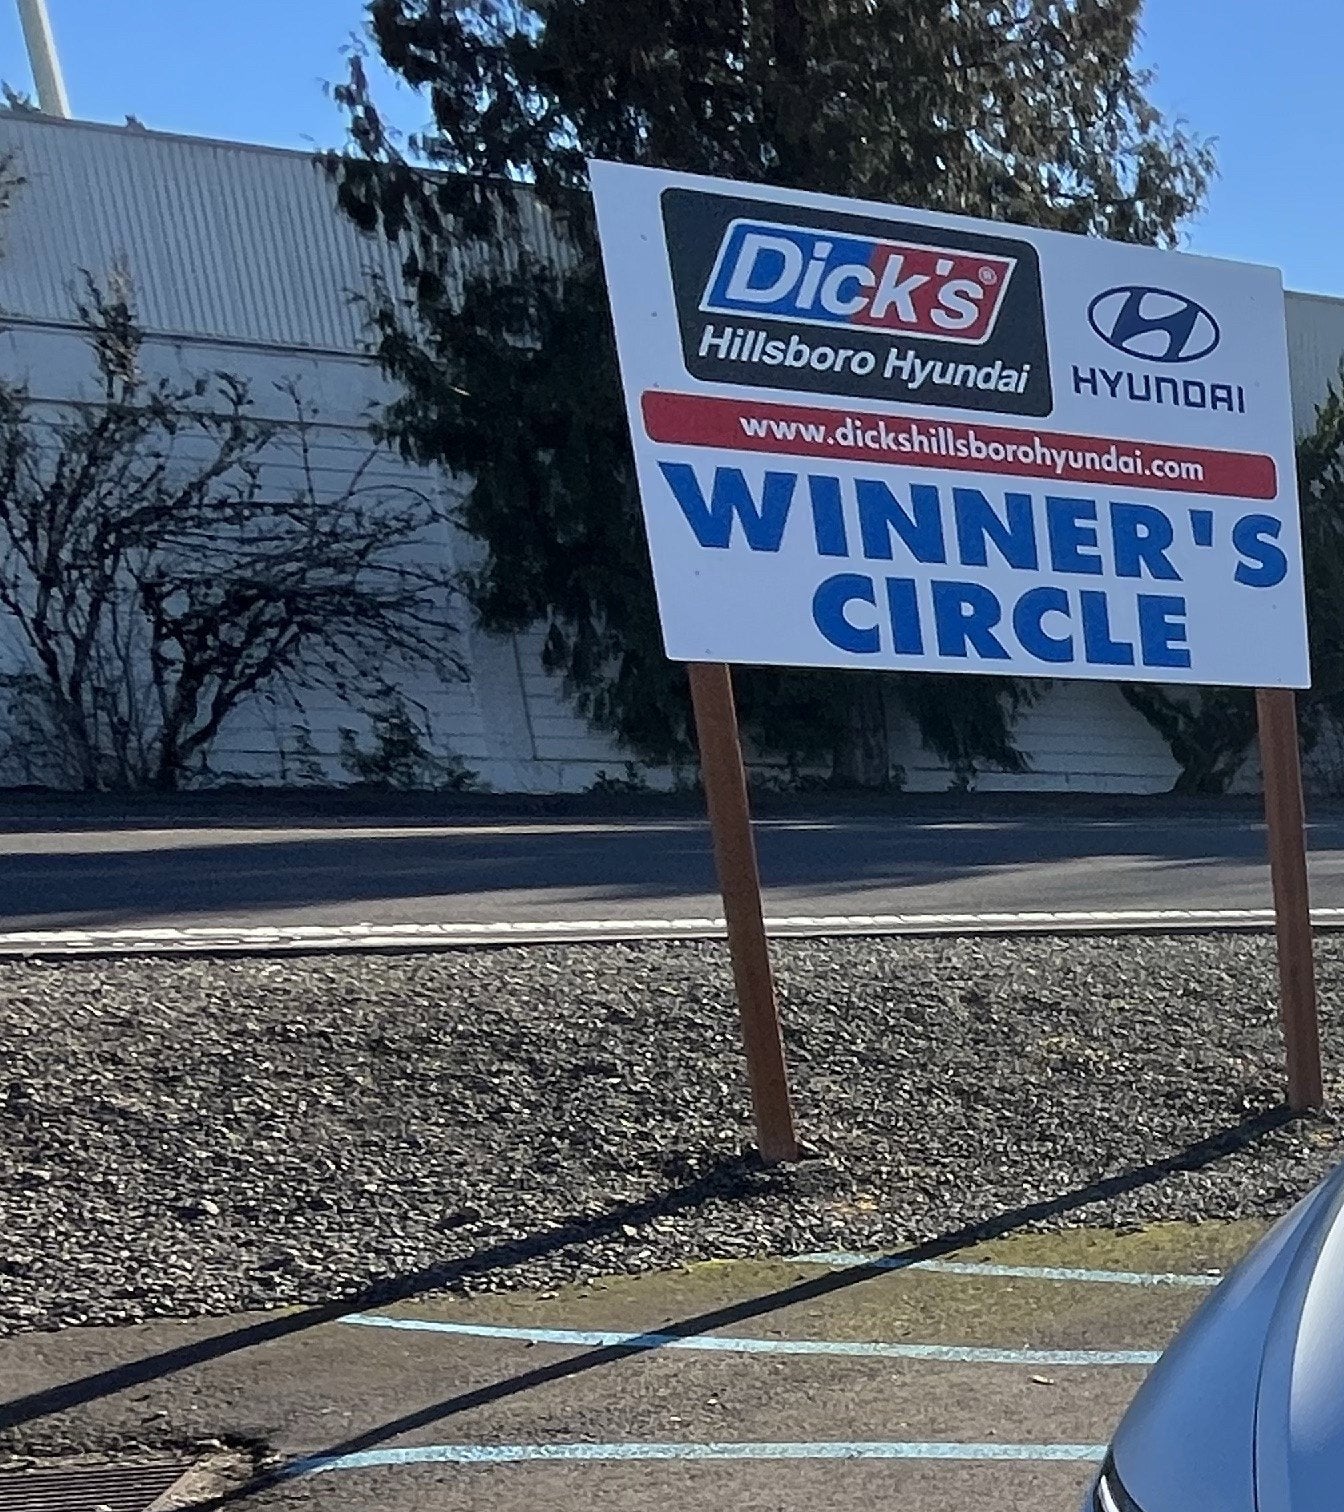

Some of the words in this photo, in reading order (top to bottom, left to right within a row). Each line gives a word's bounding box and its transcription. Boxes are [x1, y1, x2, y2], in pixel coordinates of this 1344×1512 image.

[725, 232, 985, 333] Dick's
[698, 325, 877, 378] Hillsboro
[882, 347, 1032, 396] Hyundai
[1071, 364, 1247, 414] HYUNDAI
[739, 414, 1205, 483] www.dickshillsborohyundai.com
[656, 460, 1289, 588] WINNER'S
[811, 572, 1193, 669] CIRCLE
